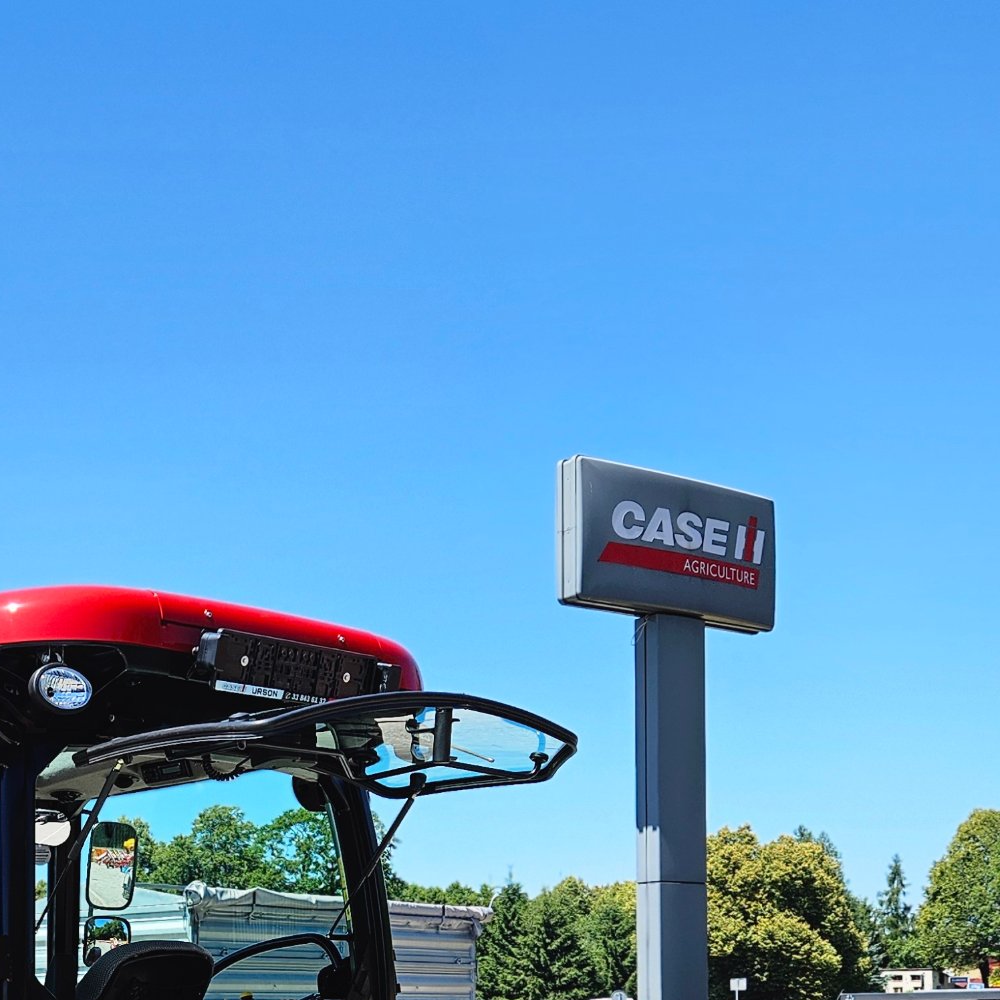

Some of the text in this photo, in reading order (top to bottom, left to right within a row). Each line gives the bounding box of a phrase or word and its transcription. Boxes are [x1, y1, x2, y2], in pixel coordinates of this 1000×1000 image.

[611, 499, 730, 557] CASE
[683, 559, 755, 586] AGRICULTURE
[251, 686, 279, 698] URSON
